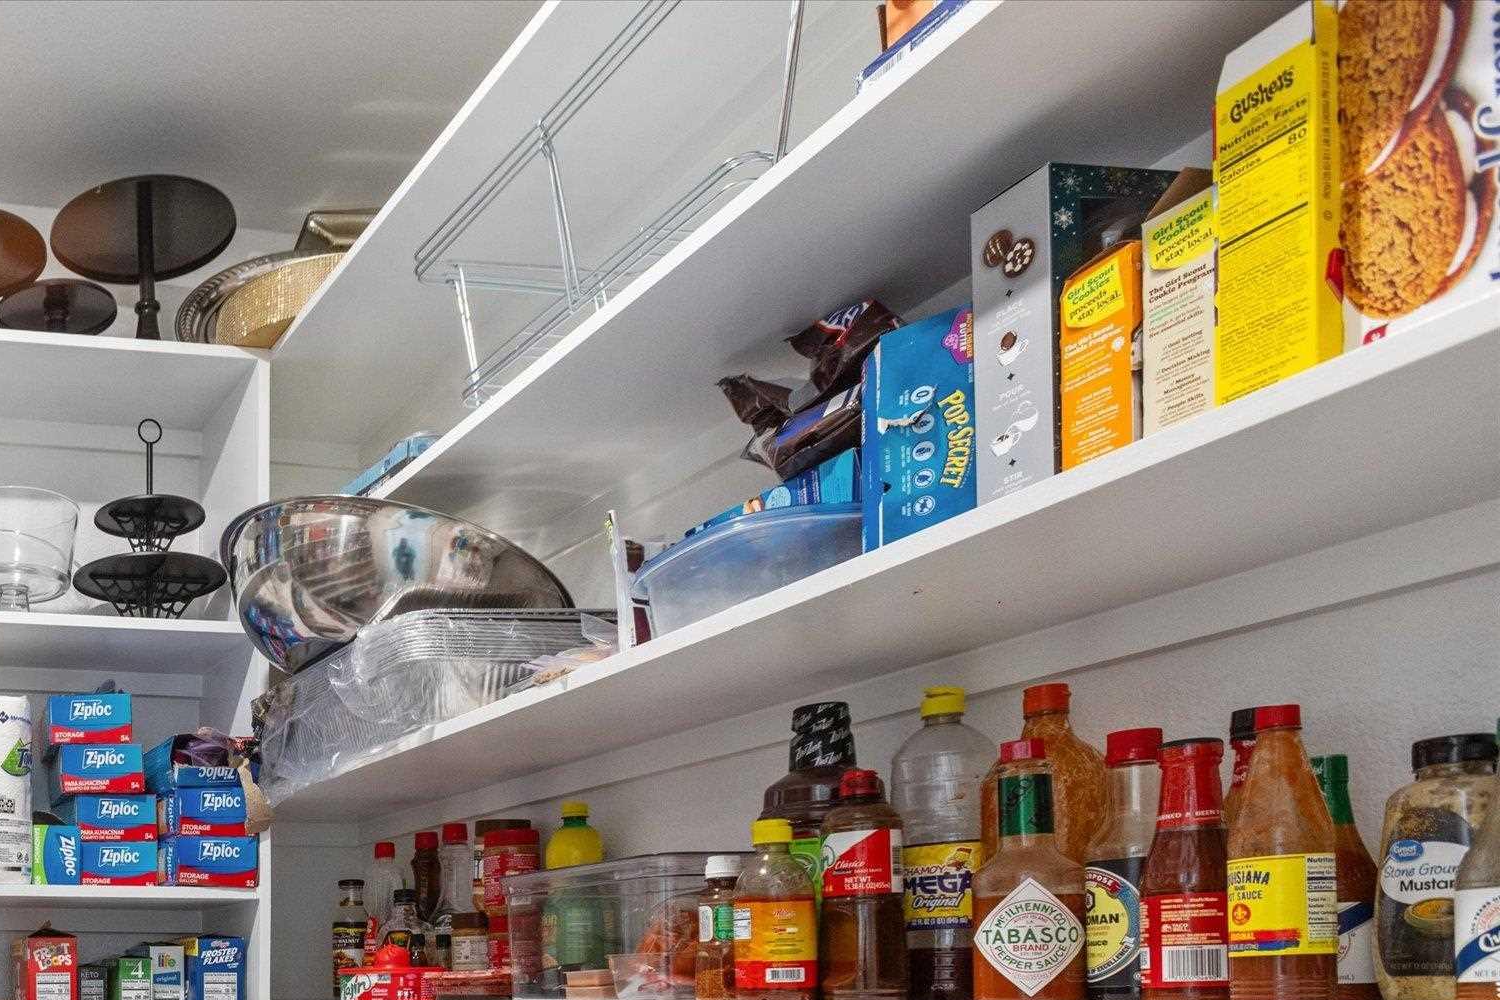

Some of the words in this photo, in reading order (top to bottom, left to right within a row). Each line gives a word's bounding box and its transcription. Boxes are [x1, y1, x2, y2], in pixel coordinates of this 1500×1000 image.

[1230, 65, 1294, 123] Gushers
[1220, 121, 1268, 152] Nutrition
[1274, 98, 1307, 121] Facts
[1220, 158, 1260, 184] Calories
[1288, 128, 1307, 144] 80
[1152, 223, 1173, 241] Girl
[1175, 201, 1210, 227] Scout
[1158, 215, 1204, 245] Cookies
[1155, 227, 1200, 261] proceeds
[1165, 247, 1185, 264] stay
[1067, 284, 1085, 300] Girl
[1088, 263, 1115, 284] Scout
[1148, 288, 1165, 297] The
[1165, 275, 1182, 289] Girl
[1183, 263, 1207, 282] Scout
[1072, 278, 1110, 305] Cookies
[1148, 287, 1176, 304] Cookie
[1070, 290, 1108, 320] proceeds
[1076, 307, 1095, 322] stay
[73, 701, 112, 720] Ziploc
[86, 749, 125, 767] Ziploc
[100, 798, 139, 818] Ziploc
[203, 793, 241, 813] Ziploc
[60, 835, 77, 876] Ziploc
[101, 847, 140, 866] Ziploc
[202, 840, 241, 859] Ziploc
[1384, 865, 1416, 878] Stone
[1400, 879, 1455, 892] Mustar
[913, 893, 963, 910] Original
[1237, 891, 1263, 900] SAUCE
[982, 926, 1079, 945] TABASCO
[201, 947, 238, 958] FROSTED
[203, 955, 234, 966] FLAKES
[995, 945, 1033, 970] PEPPER
[1035, 944, 1068, 969] SAUCE
[38, 954, 72, 971] LOOPS
[131, 961, 144, 979] 4
